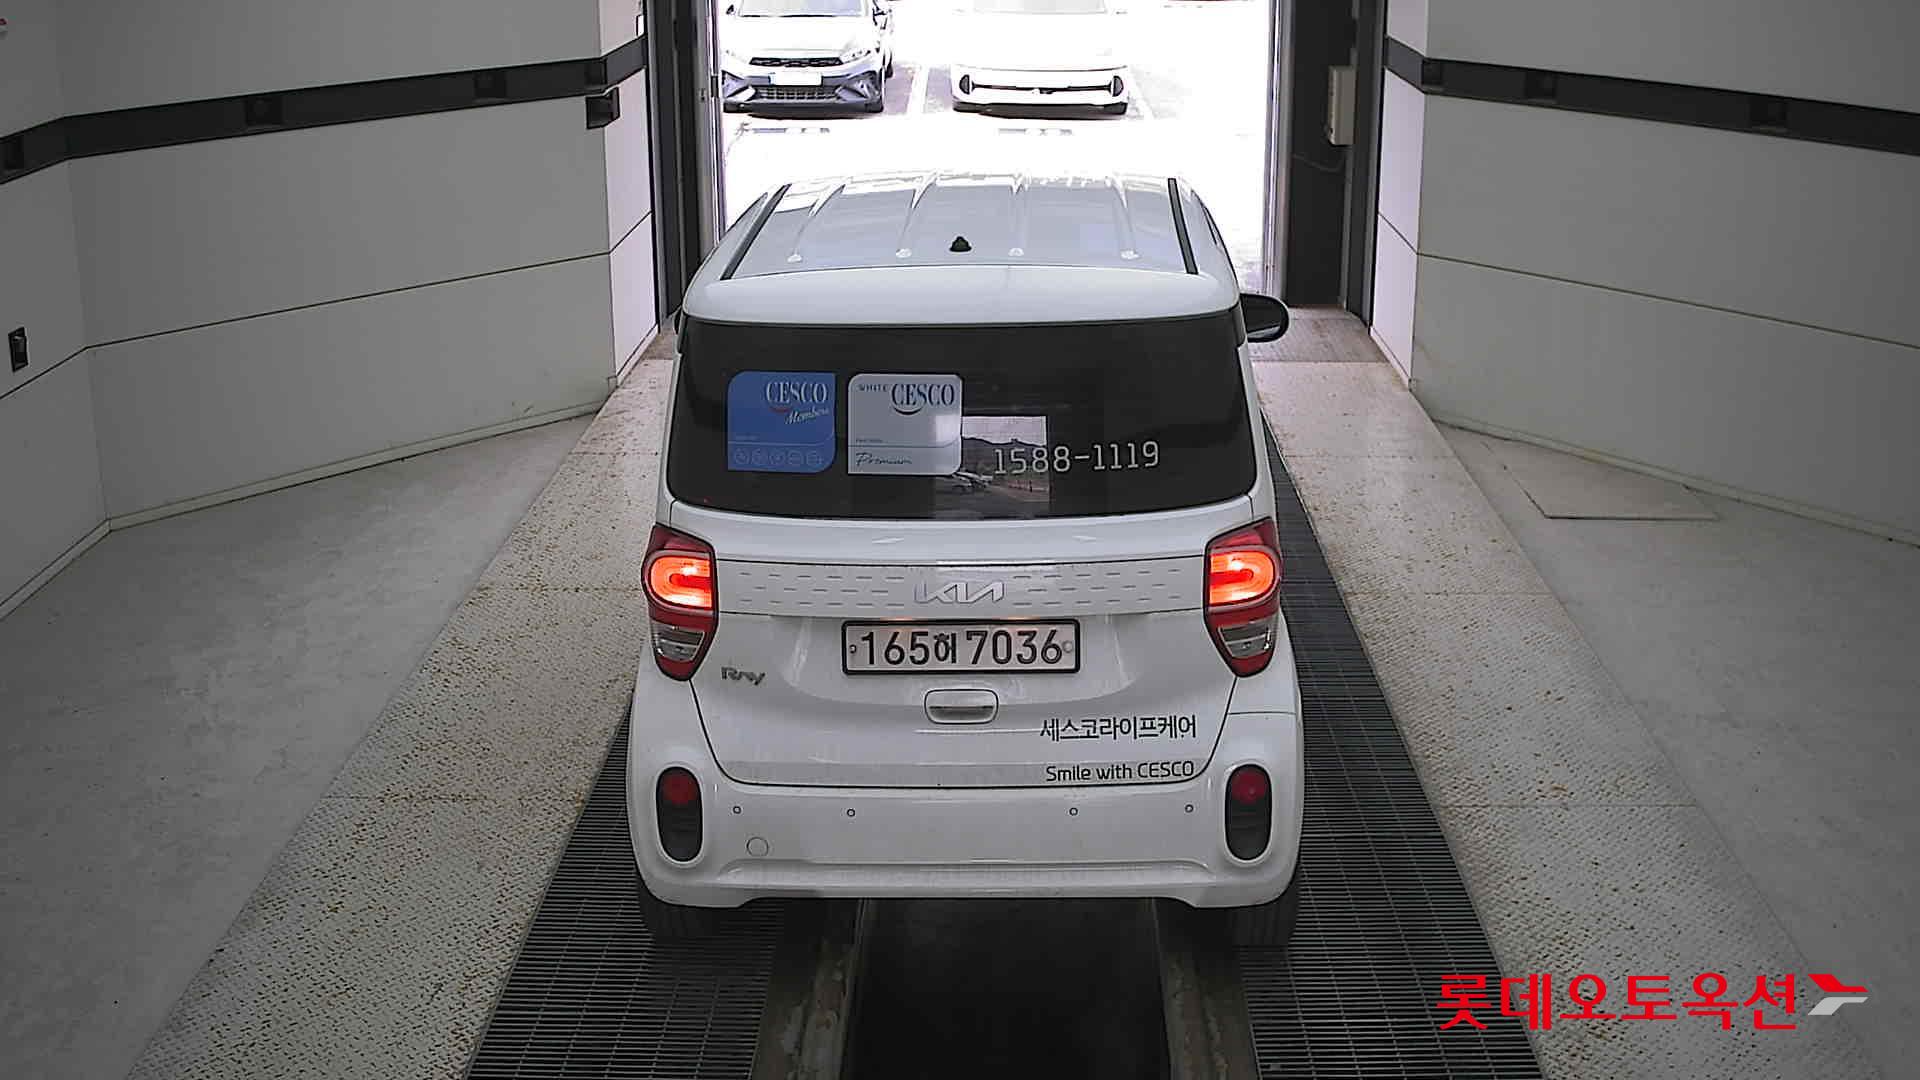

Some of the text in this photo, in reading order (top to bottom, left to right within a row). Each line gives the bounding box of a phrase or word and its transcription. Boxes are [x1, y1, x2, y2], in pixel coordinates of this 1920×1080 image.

[766, 382, 827, 403] CESCO
[891, 383, 955, 406] CESCO
[994, 440, 1159, 475] 1588-1119
[965, 629, 1063, 665] 7036
[1040, 714, 1197, 742] 세스코라이프케어
[1046, 760, 1195, 782] Smile with CESCO
